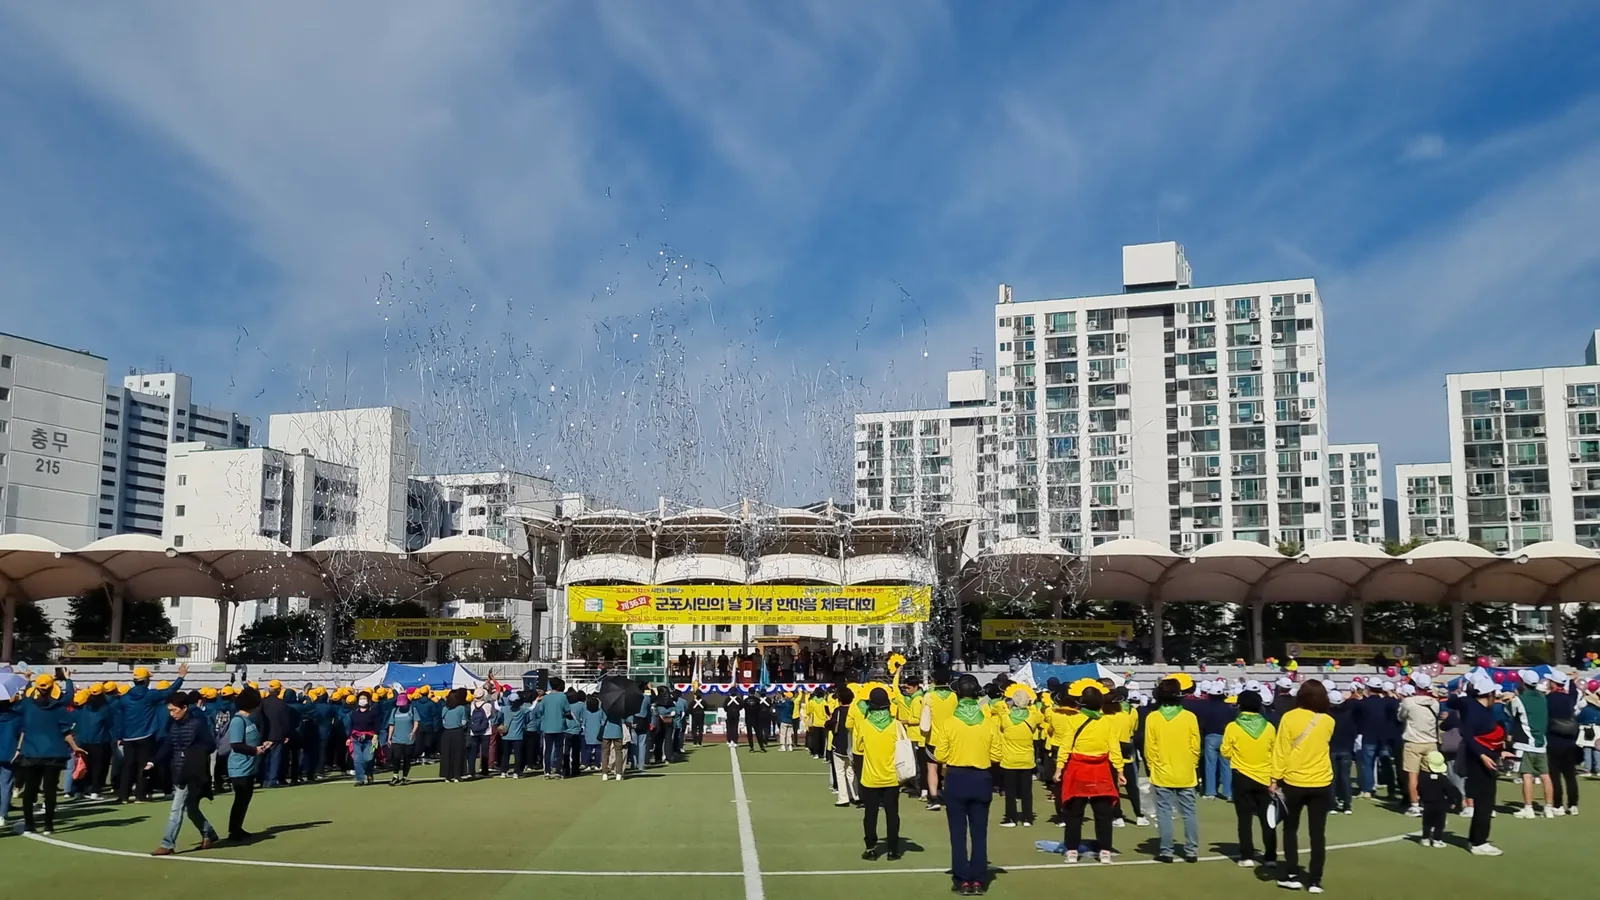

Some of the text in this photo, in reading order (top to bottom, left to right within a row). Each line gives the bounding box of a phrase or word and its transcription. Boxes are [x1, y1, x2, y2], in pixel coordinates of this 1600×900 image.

[30, 427, 69, 453] 충무
[36, 458, 60, 475] 215
[620, 596, 648, 611] 제36회
[655, 597, 876, 612] 군포시민의 날 기념 한마음 체육대회
